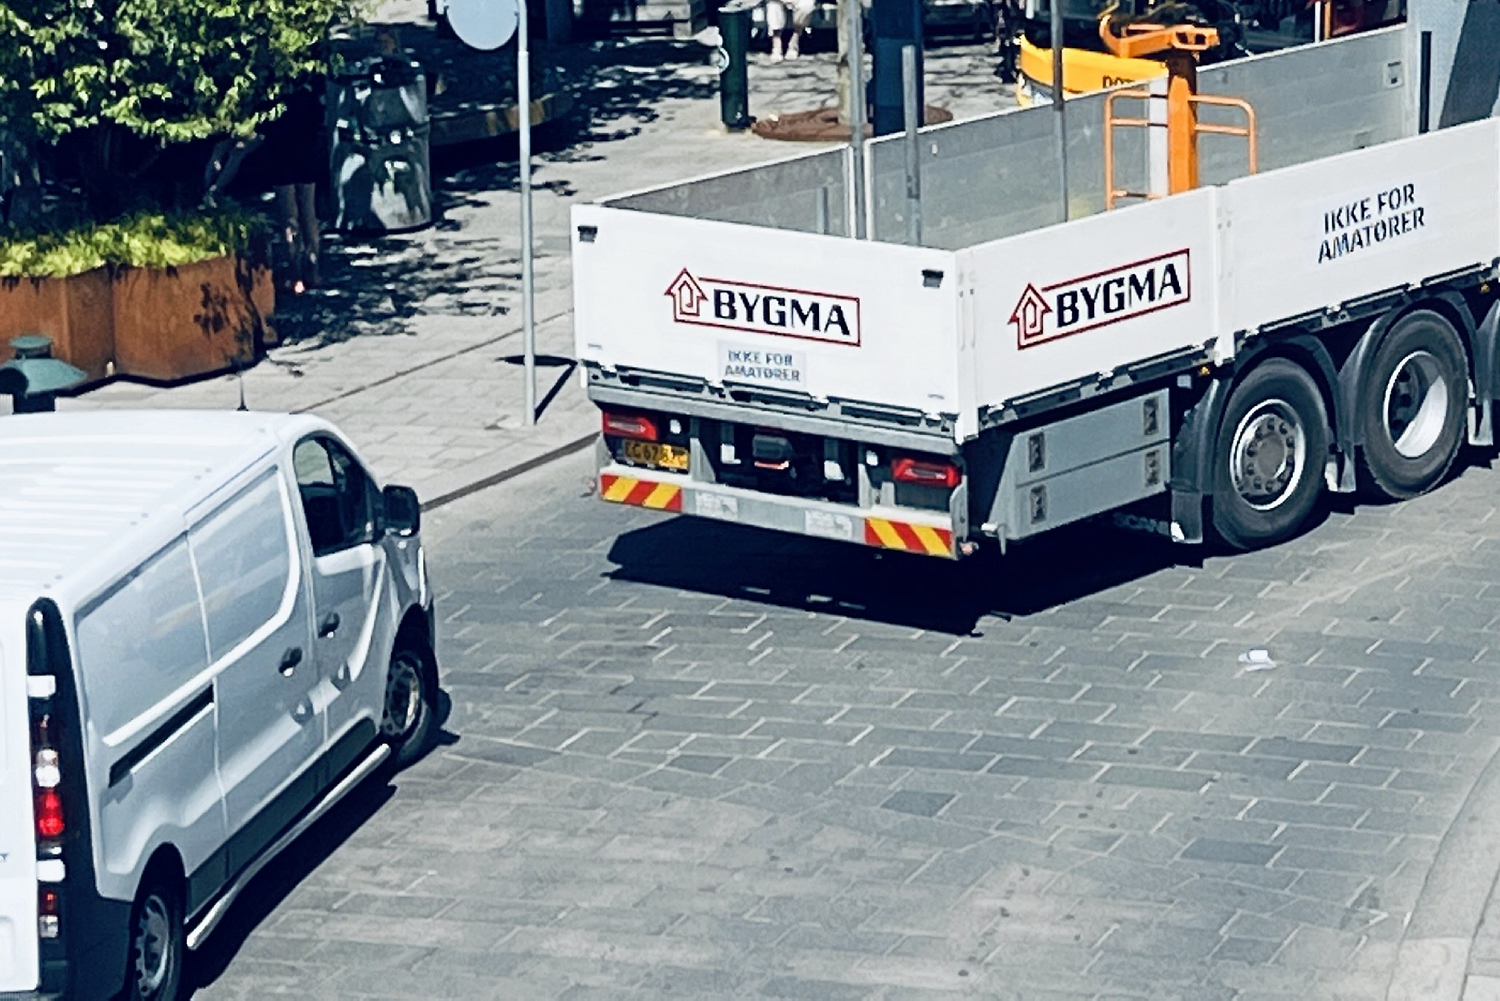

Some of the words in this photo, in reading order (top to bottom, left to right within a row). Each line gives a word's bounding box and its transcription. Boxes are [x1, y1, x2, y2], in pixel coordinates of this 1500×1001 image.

[1324, 197, 1371, 234] IKKE
[1378, 183, 1414, 214] FOR
[713, 288, 850, 335] BYGMA
[1056, 262, 1181, 328] BYGMA
[728, 350, 760, 364] IKKE
[765, 353, 793, 367] FOR
